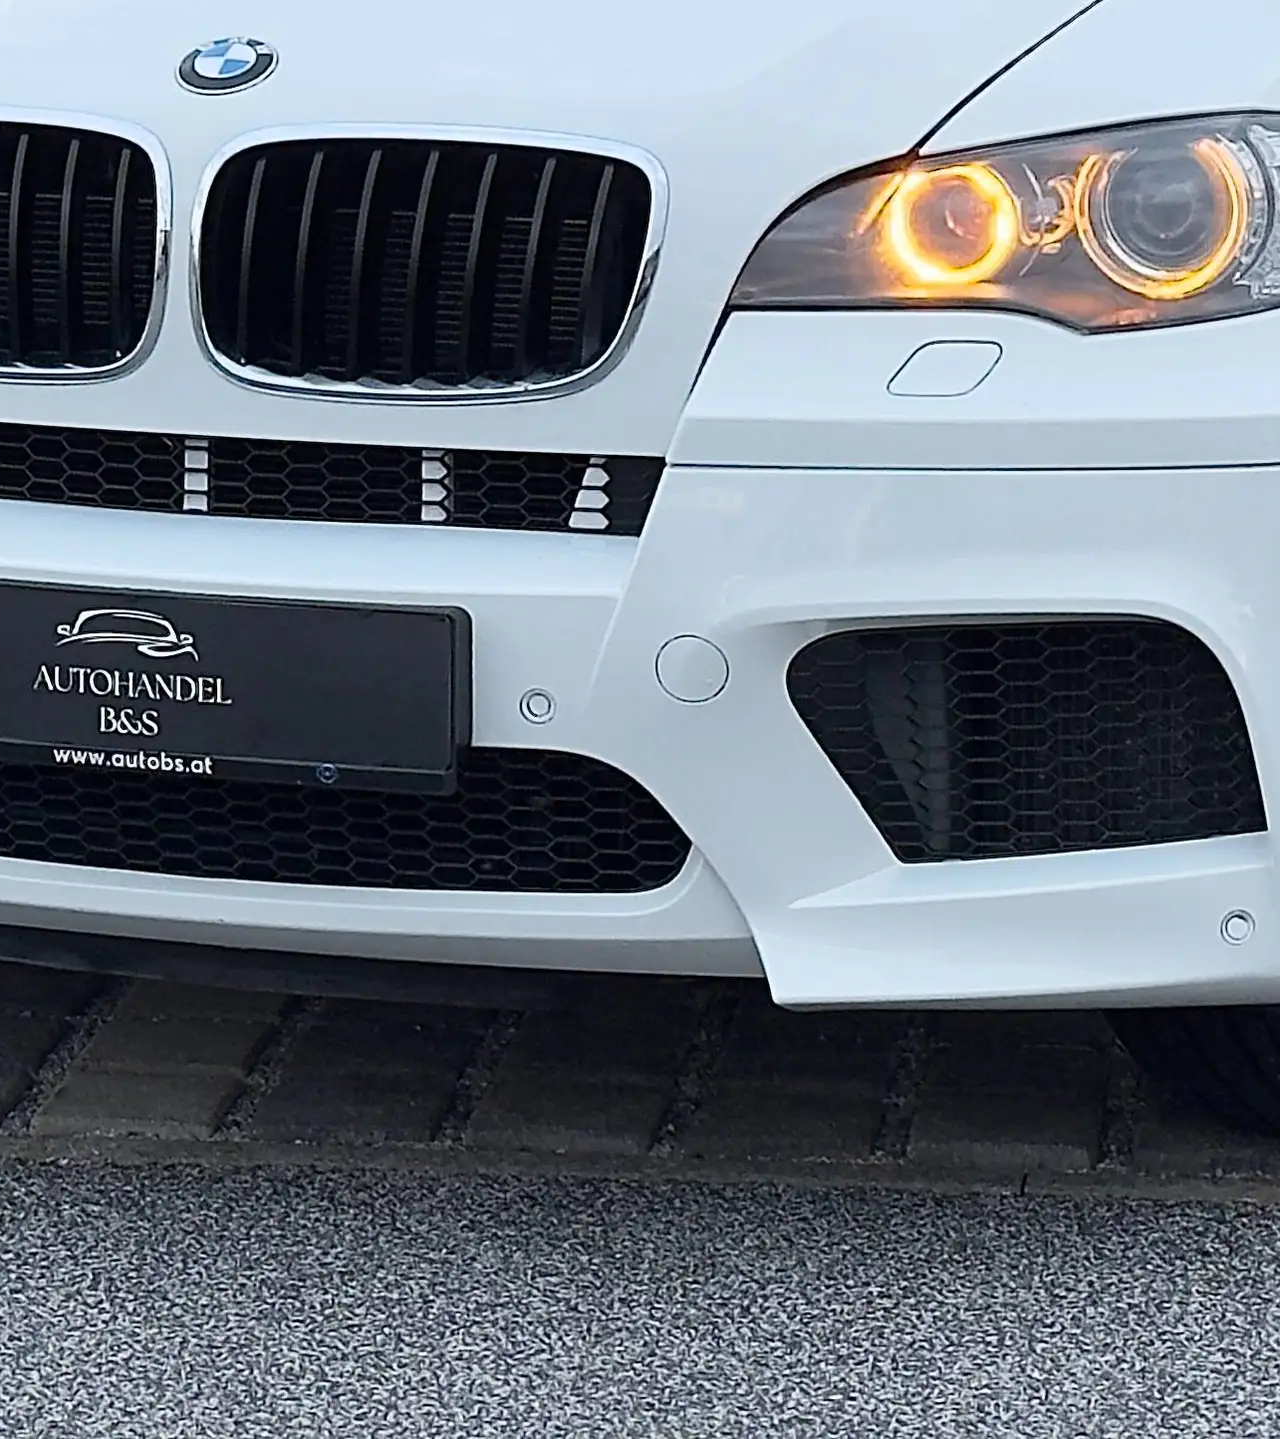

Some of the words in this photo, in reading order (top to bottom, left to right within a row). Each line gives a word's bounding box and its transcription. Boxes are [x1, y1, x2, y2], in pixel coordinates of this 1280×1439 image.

[33, 664, 233, 705] AUTOHANDEL
[99, 706, 159, 737] B&S
[53, 748, 213, 775] www.autobs.at
